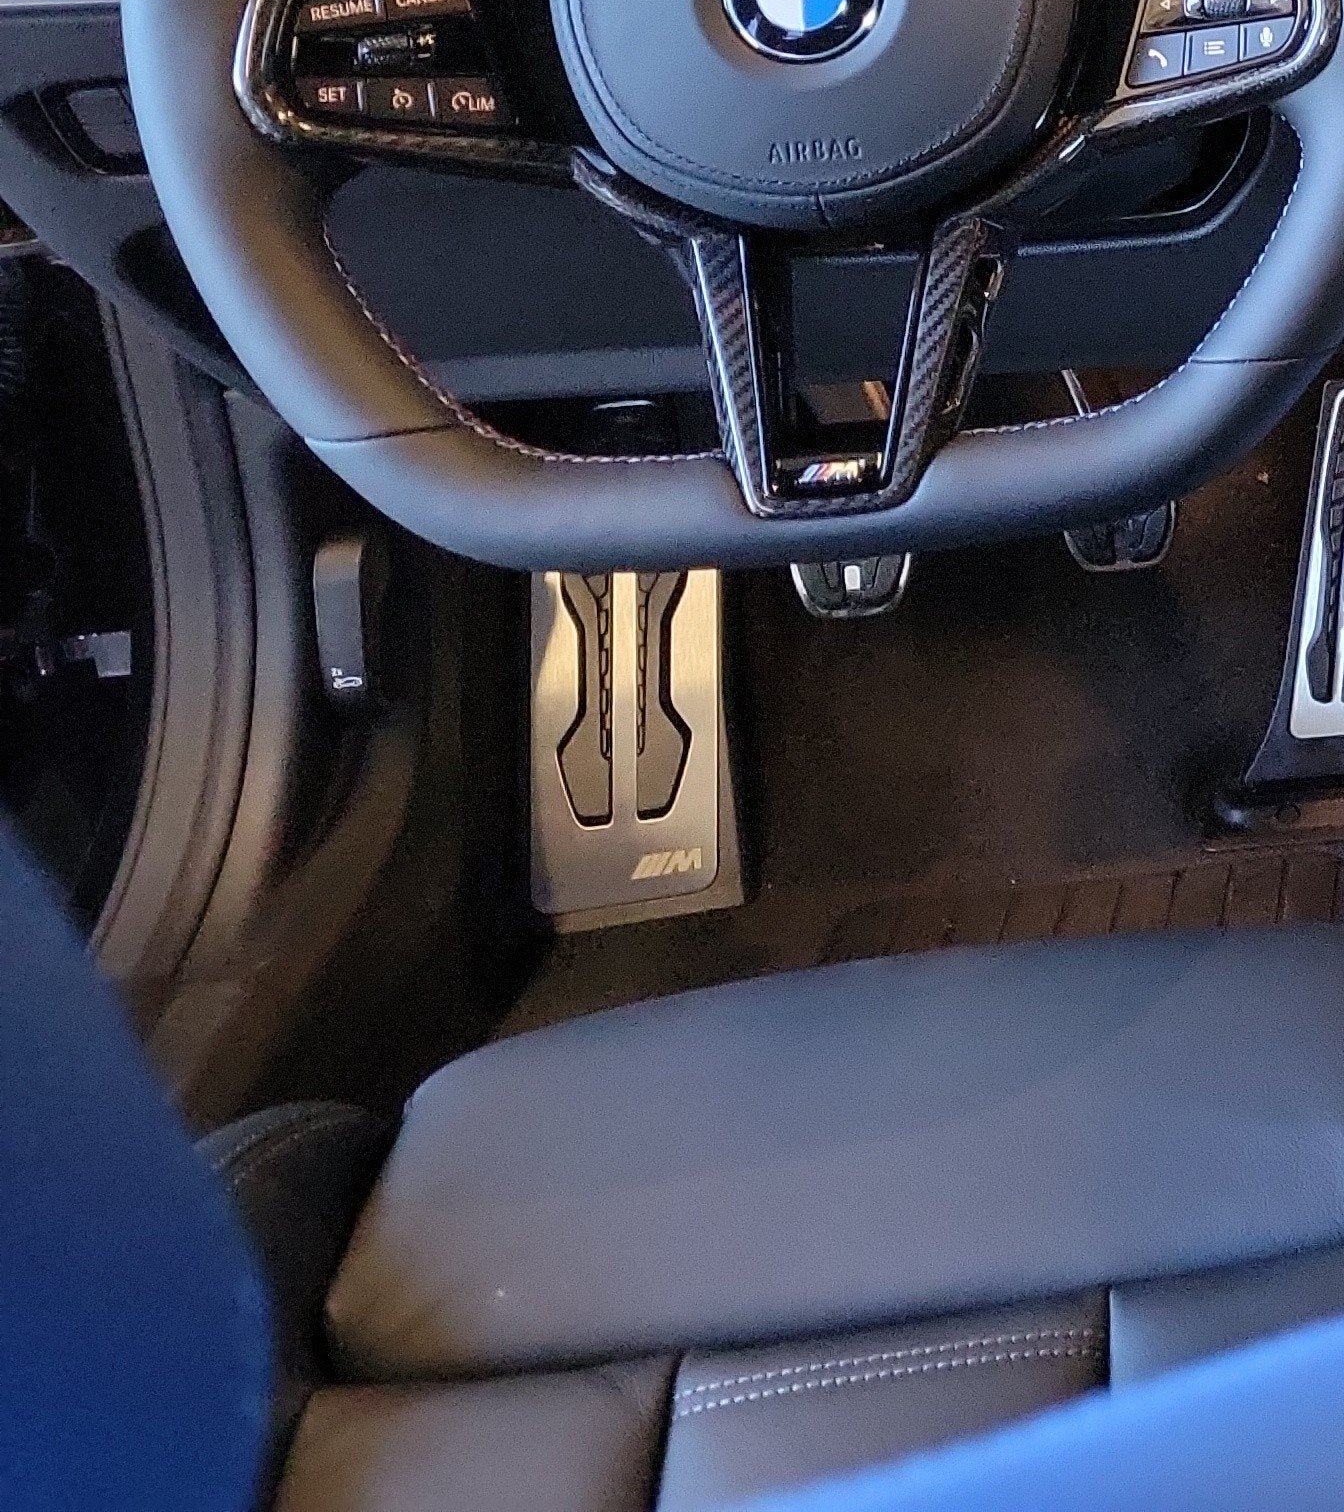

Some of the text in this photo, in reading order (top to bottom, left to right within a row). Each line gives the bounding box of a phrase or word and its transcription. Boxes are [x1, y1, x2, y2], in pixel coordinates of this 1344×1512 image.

[318, 87, 347, 103] SET
[468, 96, 496, 112] LIM
[768, 137, 863, 165] AIRBAG
